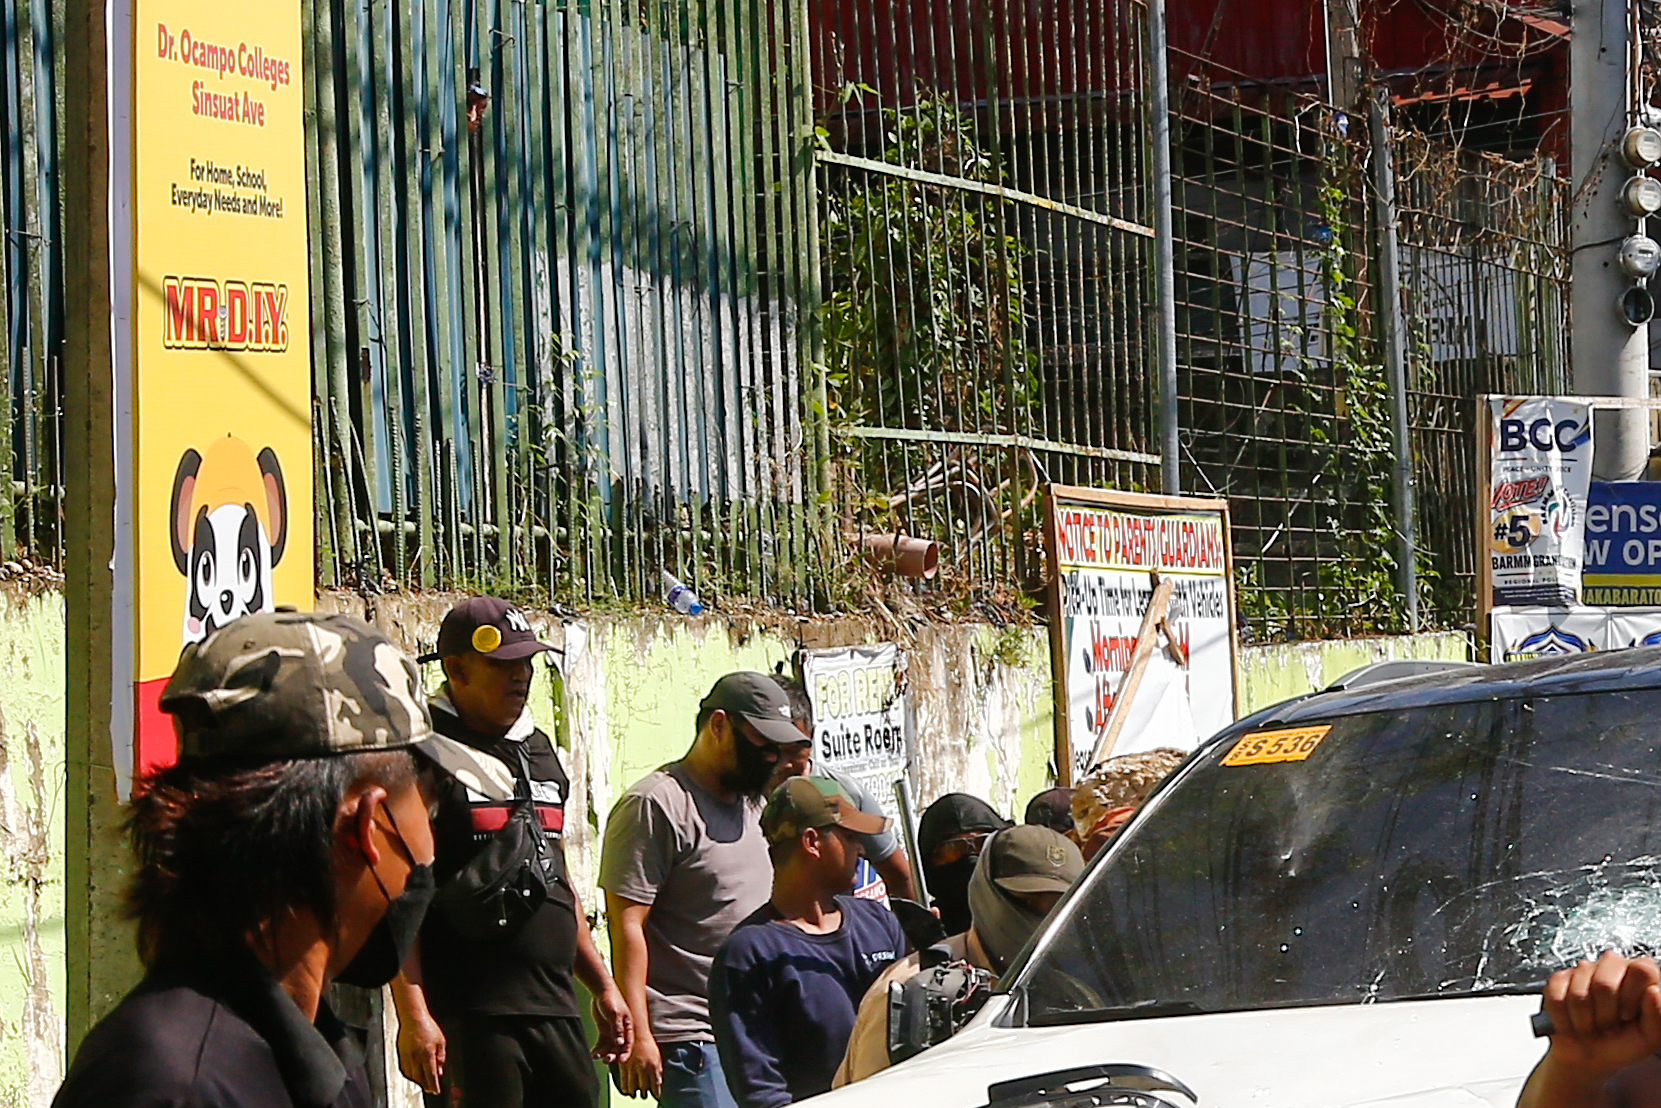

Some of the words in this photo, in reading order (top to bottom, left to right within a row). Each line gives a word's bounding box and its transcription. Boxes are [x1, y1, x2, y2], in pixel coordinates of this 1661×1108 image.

[157, 23, 178, 61] Dr.
[180, 29, 236, 79] Ocampo
[237, 43, 290, 91] Colleges
[191, 80, 240, 121] Sinsuat
[241, 94, 265, 127] Ave
[189, 158, 205, 182] For
[206, 161, 235, 190] Home,
[236, 164, 268, 192] School,
[171, 183, 213, 216] Everyday
[214, 189, 242, 215] Needs
[242, 193, 258, 216] and
[258, 194, 284, 219] More!
[1501, 418, 1579, 452] BCC
[1057, 508, 1096, 563] NOTICE
[1098, 513, 1112, 564] TO
[815, 670, 852, 721] FOR
[822, 723, 861, 760] Suite
